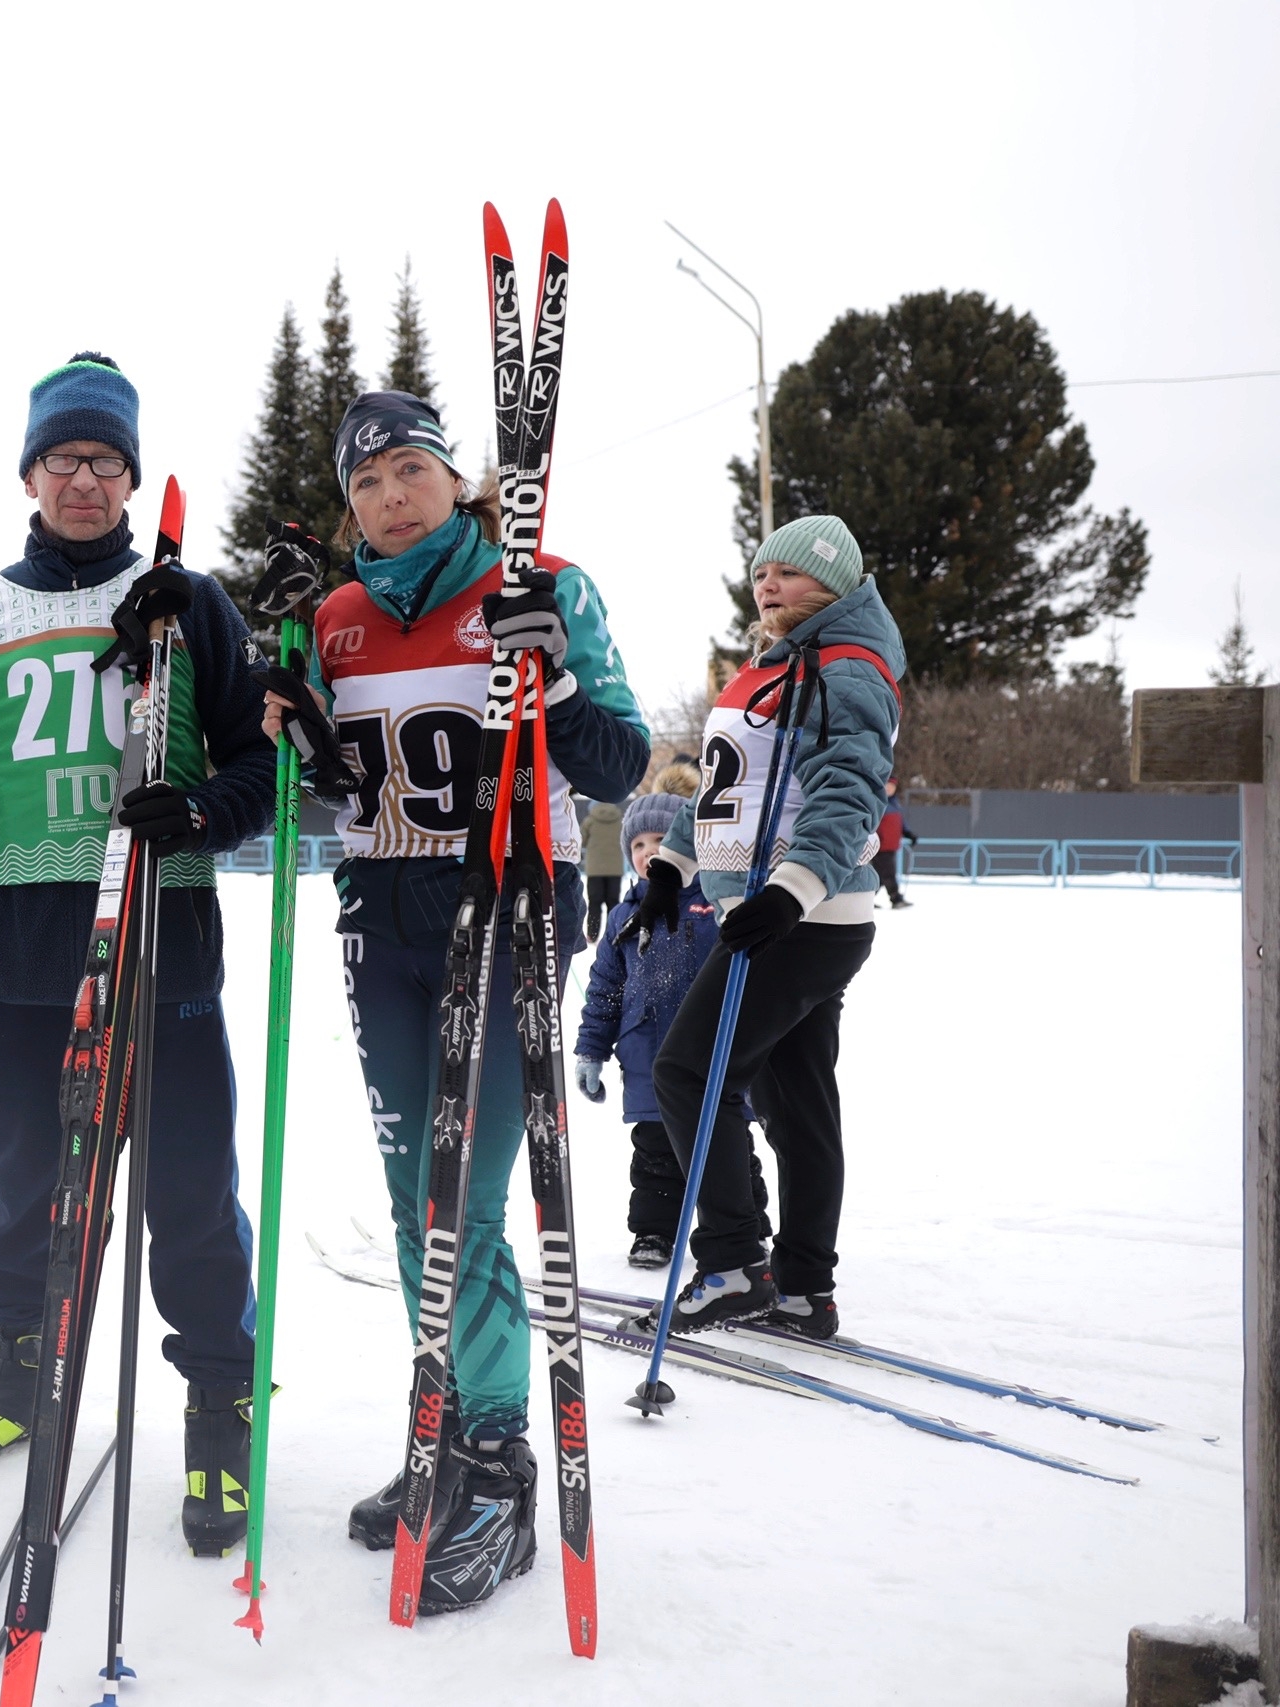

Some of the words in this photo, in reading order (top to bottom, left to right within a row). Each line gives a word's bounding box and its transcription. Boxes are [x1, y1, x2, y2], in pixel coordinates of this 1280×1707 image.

[495, 270, 520, 357] WCS
[535, 271, 568, 359] WCS
[46, 764, 119, 818] ГТО
[476, 776, 498, 811] S2
[514, 767, 533, 801] S2
[56, 1299, 72, 1355] PREMIUM
[604, 1334, 656, 1352] ATOMI
[406, 1475, 419, 1514] SKATING
[566, 1490, 575, 1533] SKATING
[19, 1544, 35, 1604] VAUHTI
[451, 1524, 514, 1587] SPINE
